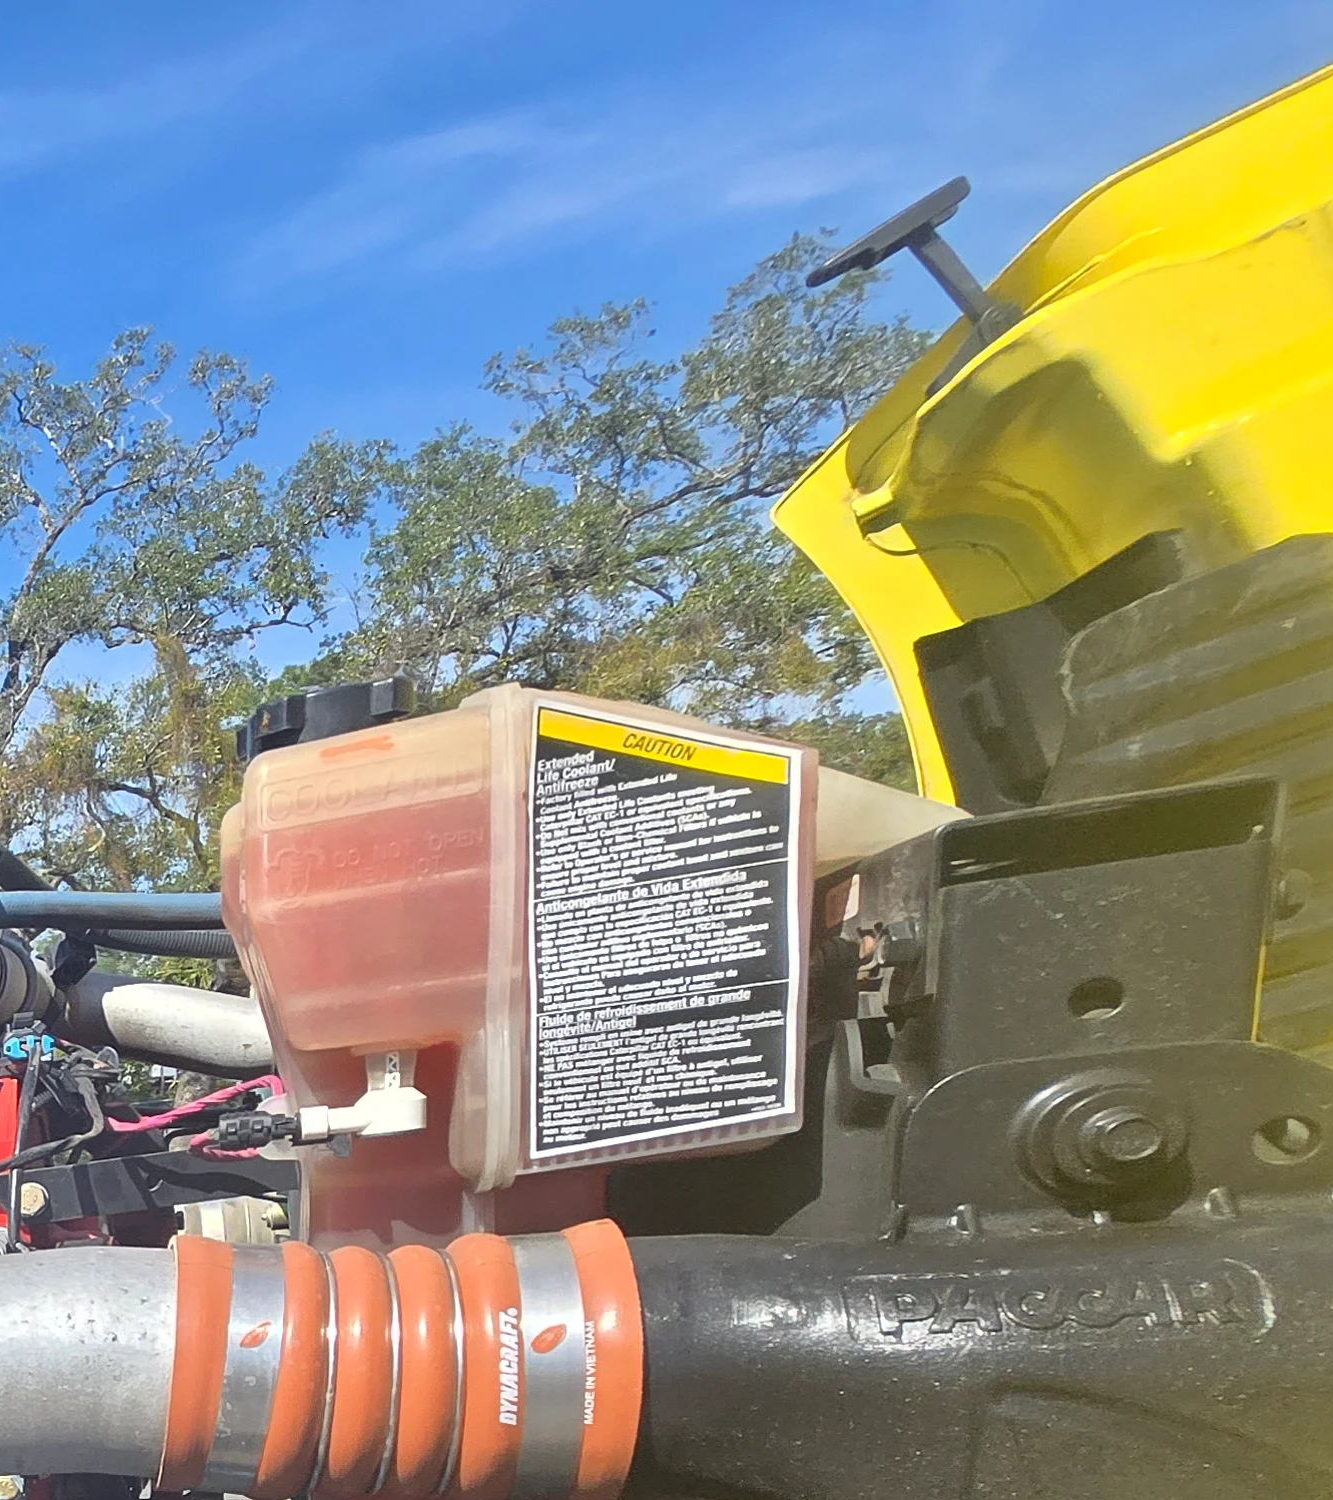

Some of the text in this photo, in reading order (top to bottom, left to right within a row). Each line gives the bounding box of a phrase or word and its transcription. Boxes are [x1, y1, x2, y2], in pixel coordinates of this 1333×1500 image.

[537, 751, 594, 772] Extended
[622, 733, 696, 762] CAUTION
[537, 758, 616, 783] Life Coolant/
[536, 776, 599, 797] Antifreeze
[586, 814, 602, 823] CAT
[604, 810, 624, 820] EC-1
[429, 828, 484, 850] OPEN
[536, 871, 748, 915] Anticongelante de Vida Extendida
[539, 1014, 574, 1029] Fluide
[576, 1010, 592, 1023] de
[689, 995, 706, 1006] de
[868, 1276, 1253, 1340] PACCAR
[498, 1309, 518, 1426] DYNACRAFT
[583, 1320, 597, 1425] MADE IN VIETNAM
